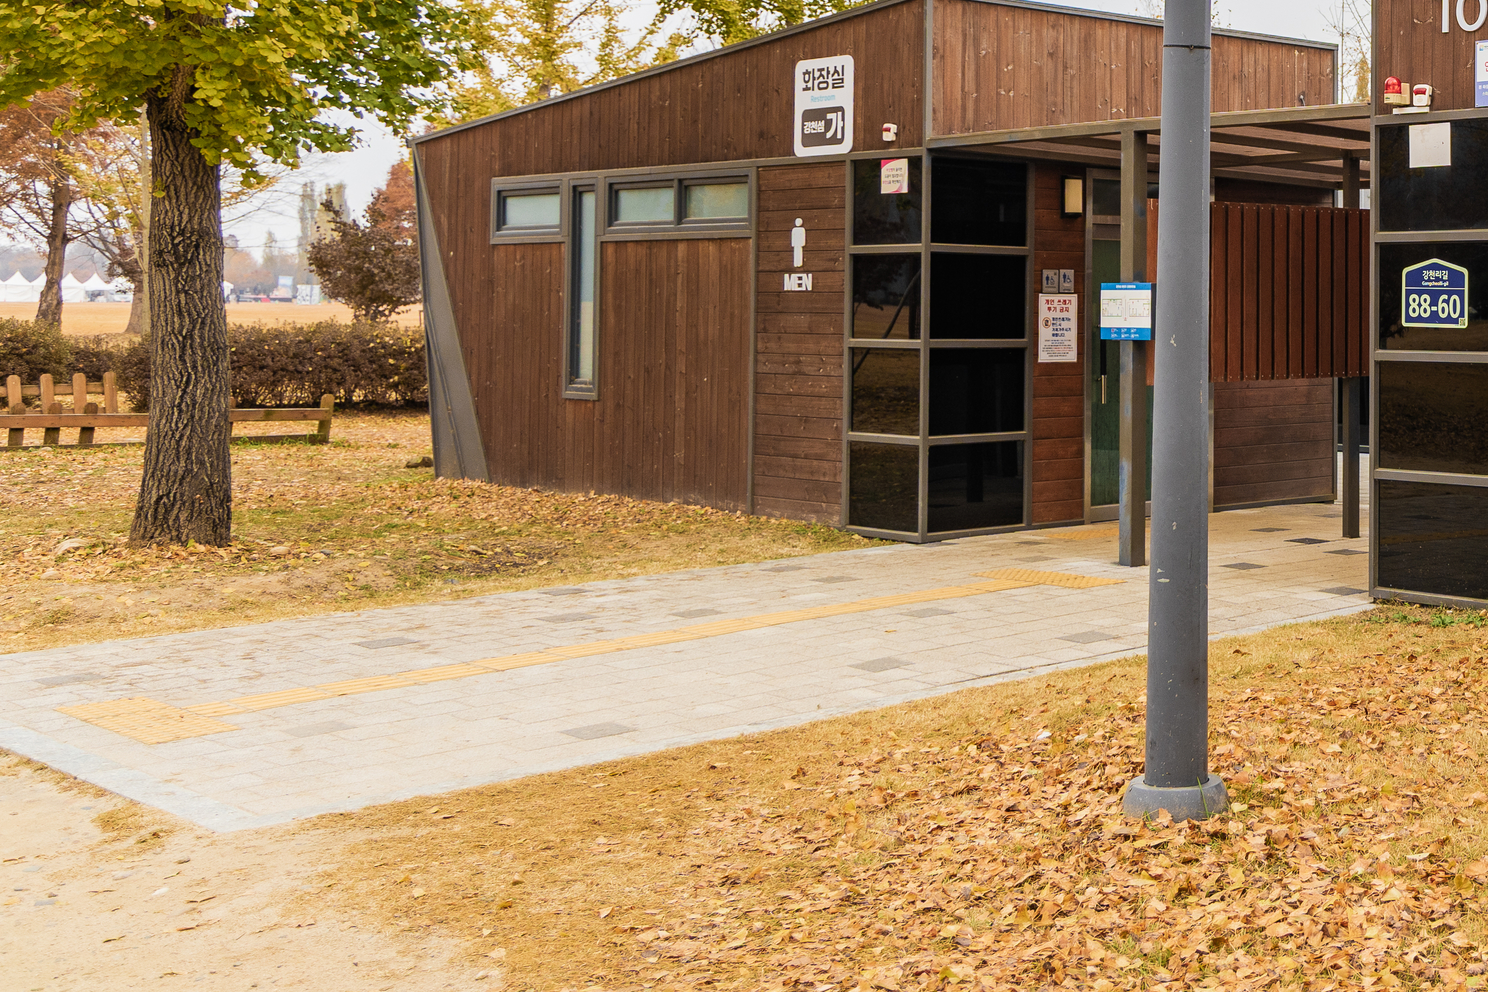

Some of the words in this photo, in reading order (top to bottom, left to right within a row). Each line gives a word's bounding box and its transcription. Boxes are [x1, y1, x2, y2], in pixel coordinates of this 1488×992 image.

[802, 64, 845, 92] 화장실
[810, 94, 836, 102] Restroom
[803, 119, 825, 134] 강천섬
[826, 111, 843, 139] 가
[783, 273, 812, 291] MEN
[1422, 270, 1448, 280] 강천리길
[1408, 293, 1461, 319] 88-60
